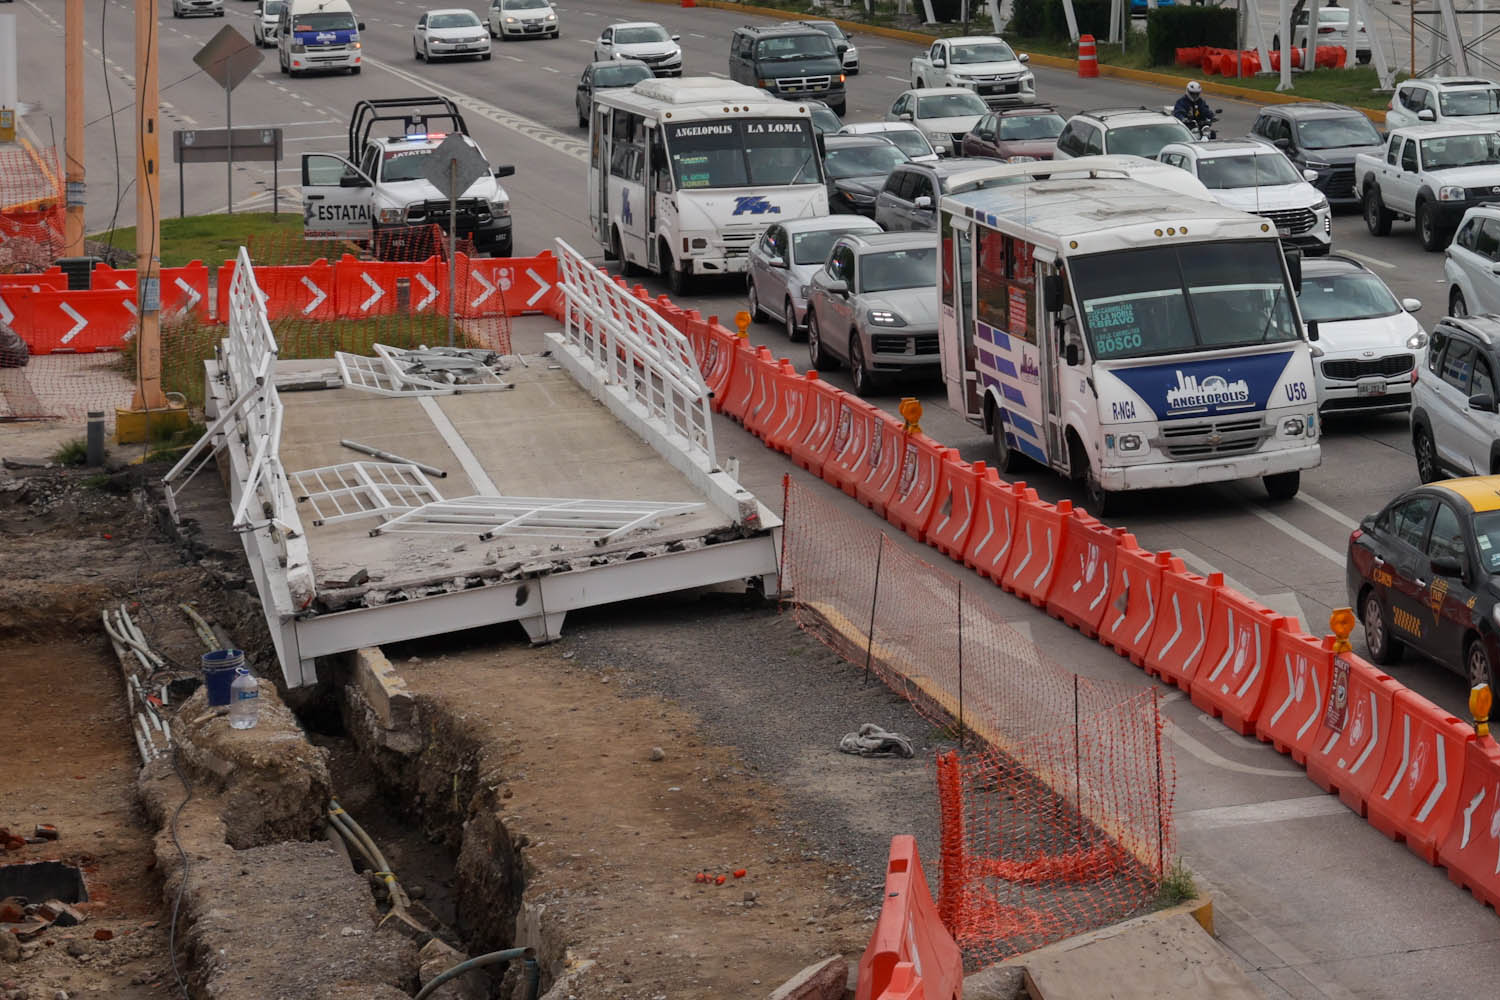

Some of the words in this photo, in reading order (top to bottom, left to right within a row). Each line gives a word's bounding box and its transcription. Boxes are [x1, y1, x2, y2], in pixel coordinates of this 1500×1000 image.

[675, 125, 733, 137] ANGELOPOLIS
[747, 124, 761, 133] LA
[767, 123, 802, 133] LOMA
[1096, 334, 1142, 353] BOSCO
[1171, 390, 1248, 408] ANGELOPOLIS
[1285, 381, 1308, 402] U58
[1112, 400, 1137, 421] R-NGA
